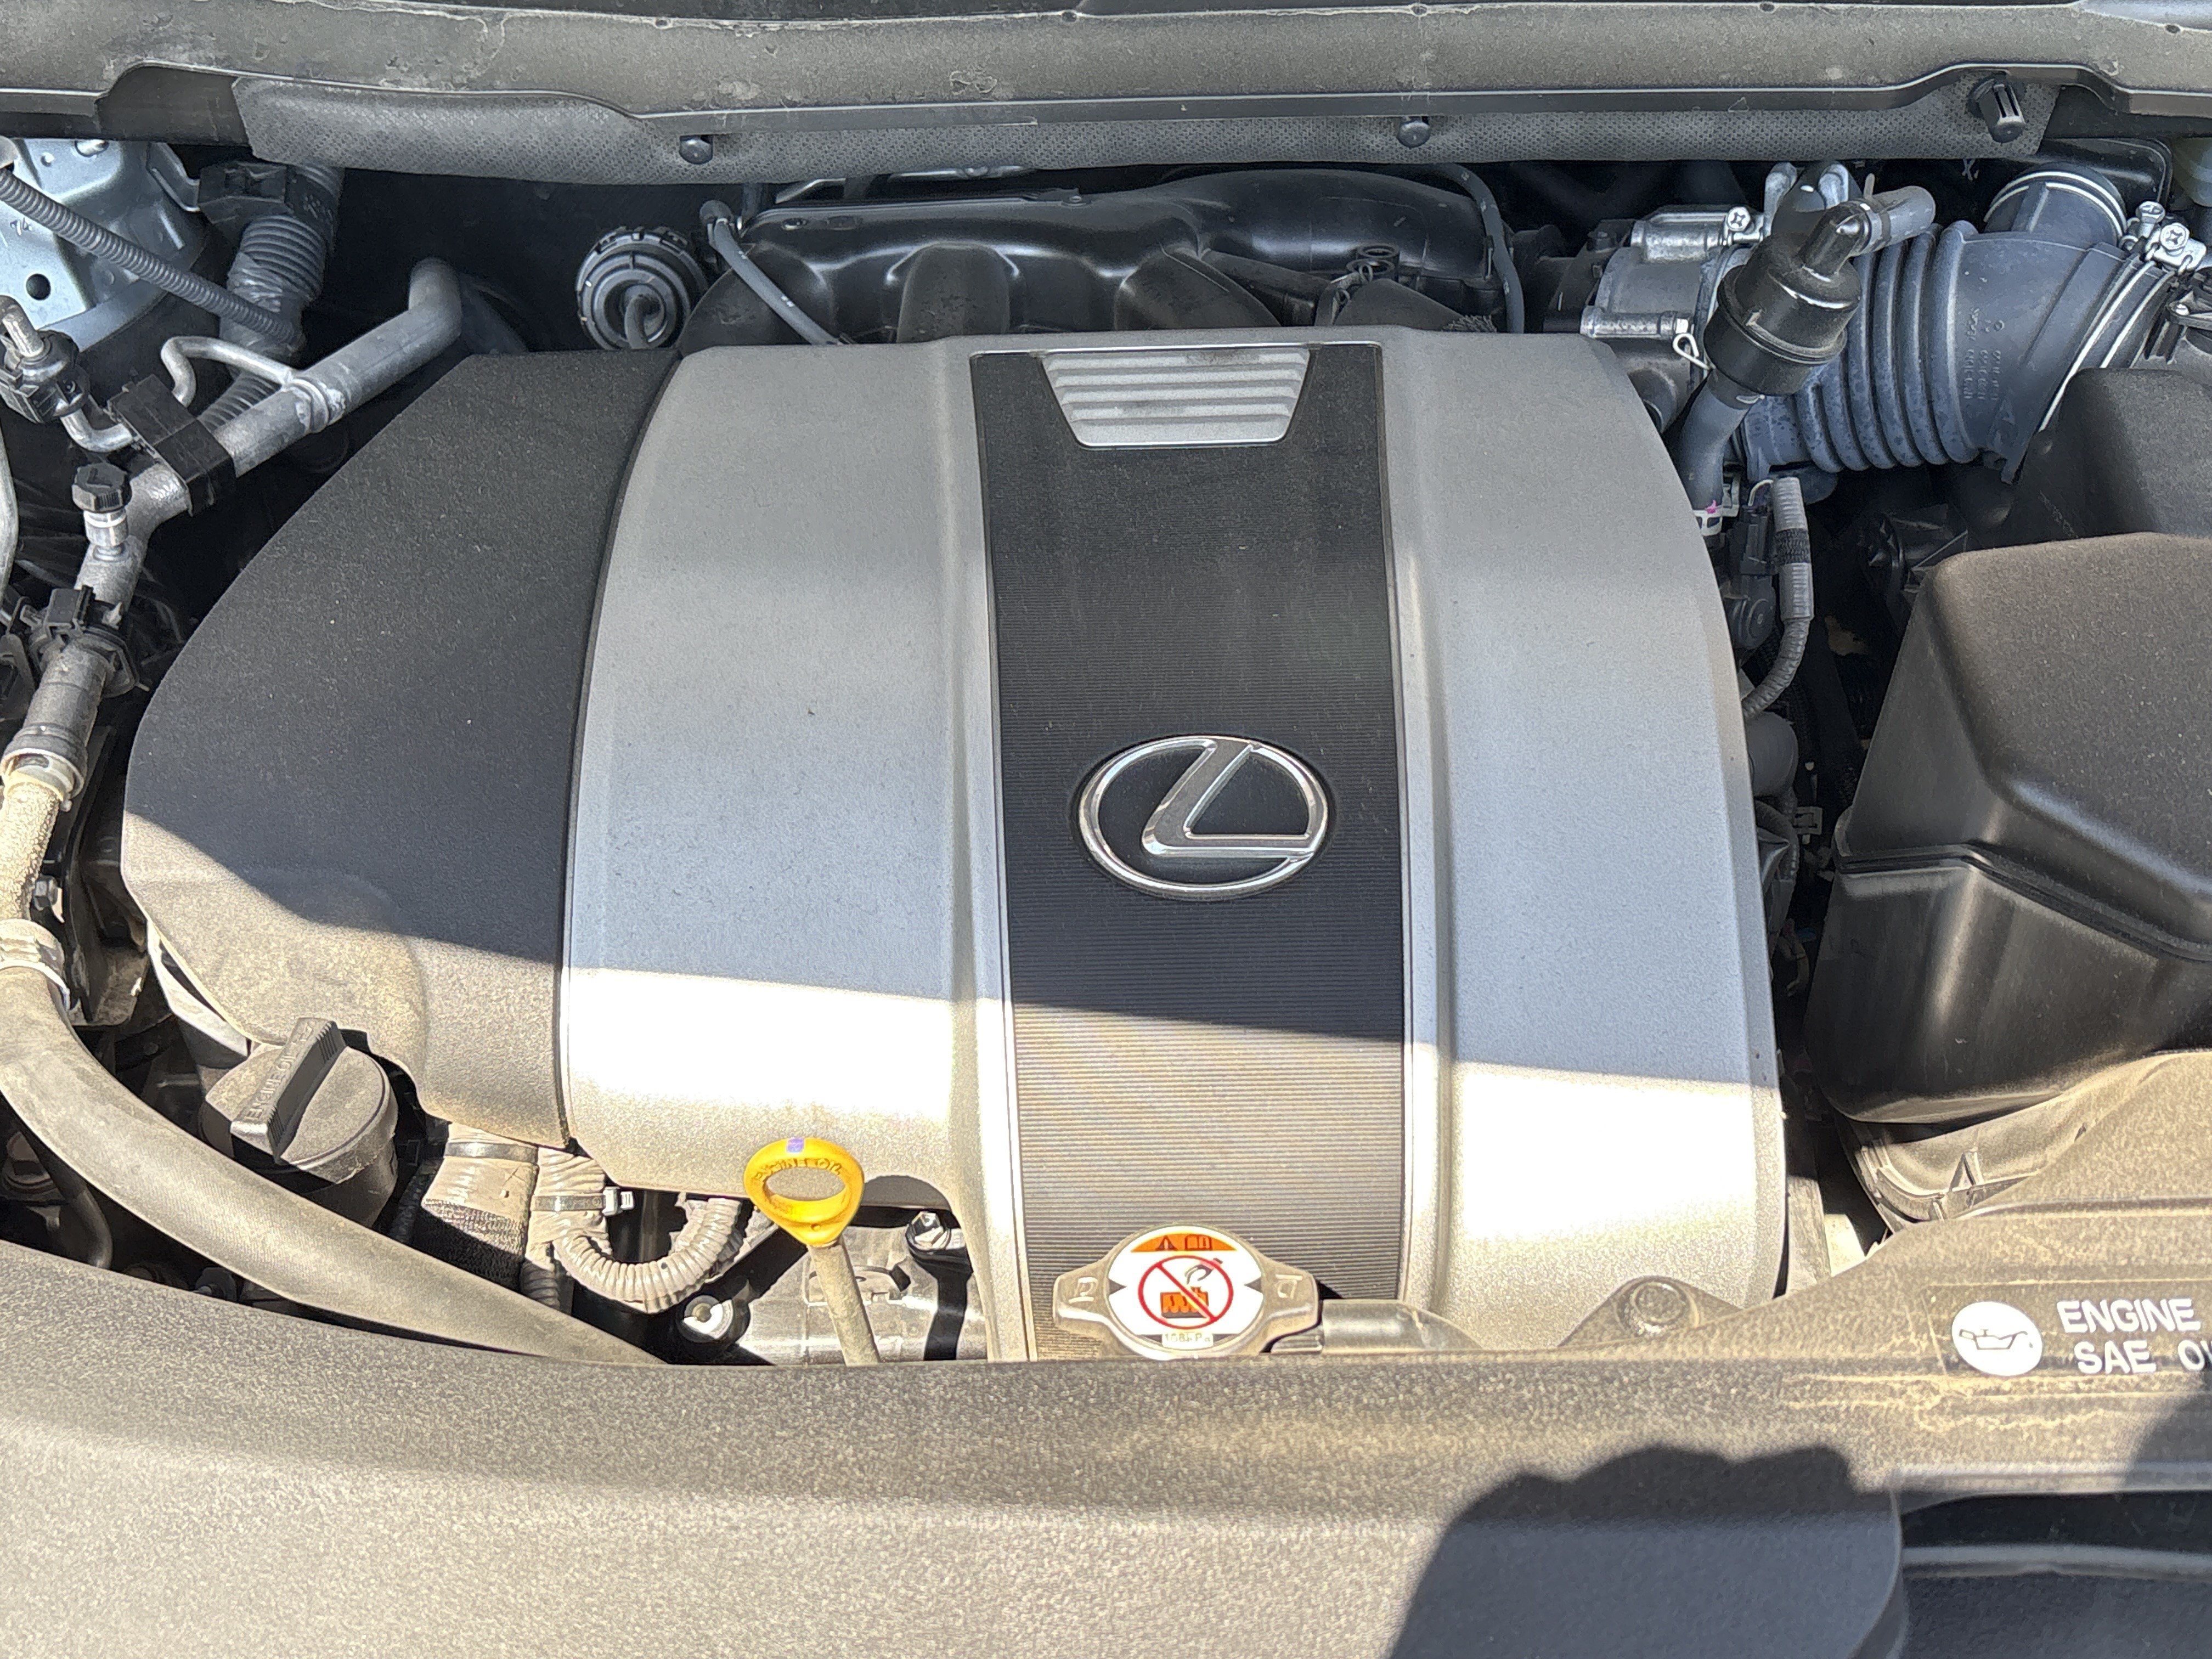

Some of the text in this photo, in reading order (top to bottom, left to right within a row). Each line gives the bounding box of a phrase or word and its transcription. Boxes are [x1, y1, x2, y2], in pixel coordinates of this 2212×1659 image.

[815, 1158, 843, 1175] OIL
[2056, 1298, 2201, 1333] ENGINE
[2074, 1340, 2157, 1374] SAE
